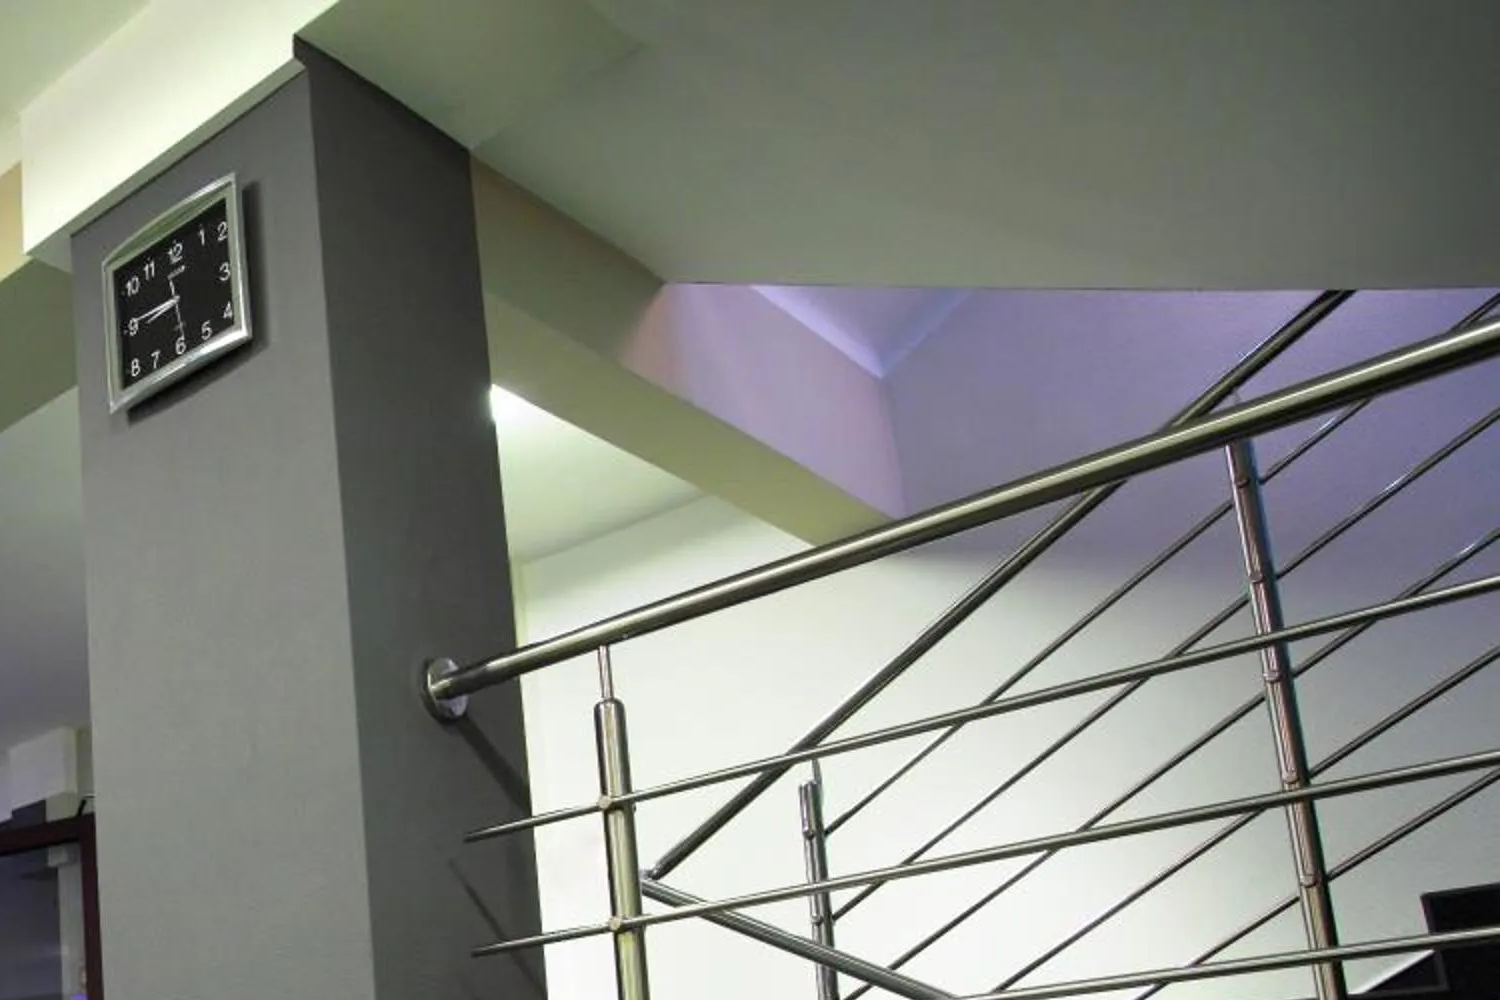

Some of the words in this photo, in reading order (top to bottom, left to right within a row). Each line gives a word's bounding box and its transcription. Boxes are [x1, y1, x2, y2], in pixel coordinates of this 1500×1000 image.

[198, 226, 205, 246] 1
[217, 221, 228, 242] 2
[167, 243, 183, 264] 12
[143, 259, 155, 281] 11
[219, 261, 231, 281] 3
[126, 275, 140, 297] 10
[223, 301, 233, 319] 4
[128, 317, 139, 337] 9
[201, 319, 213, 341] 5
[175, 335, 186, 355] 6
[131, 357, 141, 377] 8
[151, 350, 161, 369] 7
